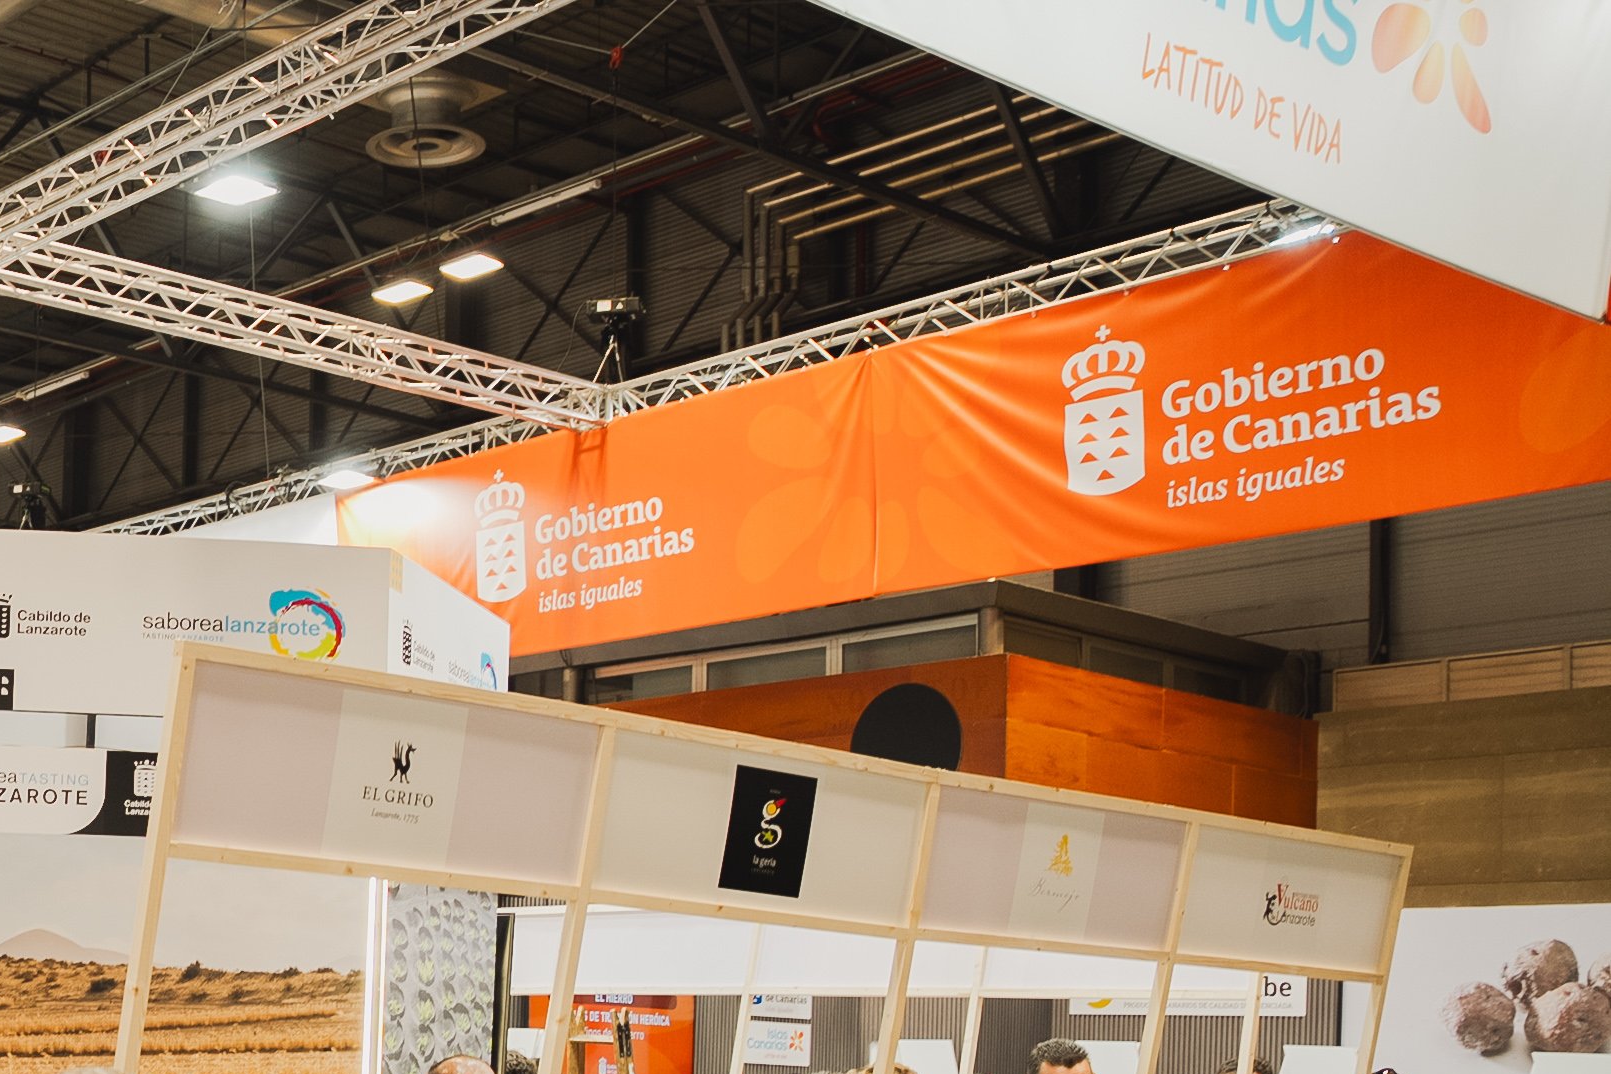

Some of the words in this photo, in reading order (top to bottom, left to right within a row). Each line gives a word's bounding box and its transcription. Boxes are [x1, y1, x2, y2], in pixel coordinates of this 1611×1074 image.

[1141, 32, 1244, 120] LATITUD
[1254, 86, 1284, 138] DE
[1292, 102, 1341, 164] VIDA
[1162, 347, 1386, 420] Gobierno
[1162, 426, 1215, 466] de
[1222, 384, 1442, 454] Canarias
[1166, 473, 1228, 508] islas
[1236, 456, 1346, 502] iguales
[535, 496, 664, 545] Gobierno
[535, 550, 567, 580] de
[571, 527, 695, 574] Canarias
[538, 588, 576, 614] islas
[580, 578, 643, 610] iguales
[16, 622, 88, 637] Lanzarote
[17, 608, 69, 624] Cabildo
[73, 610, 92, 624] de
[362, 785, 381, 801] EL
[384, 788, 434, 808] GRIFO
[752, 854, 759, 866] la
[759, 856, 777, 869] geria
[1277, 883, 1319, 913] Vulcano
[595, 993, 605, 1003] EL
[606, 993, 634, 1005] HIERRO
[1263, 976, 1292, 997] be
[590, 1011, 600, 1022] DE
